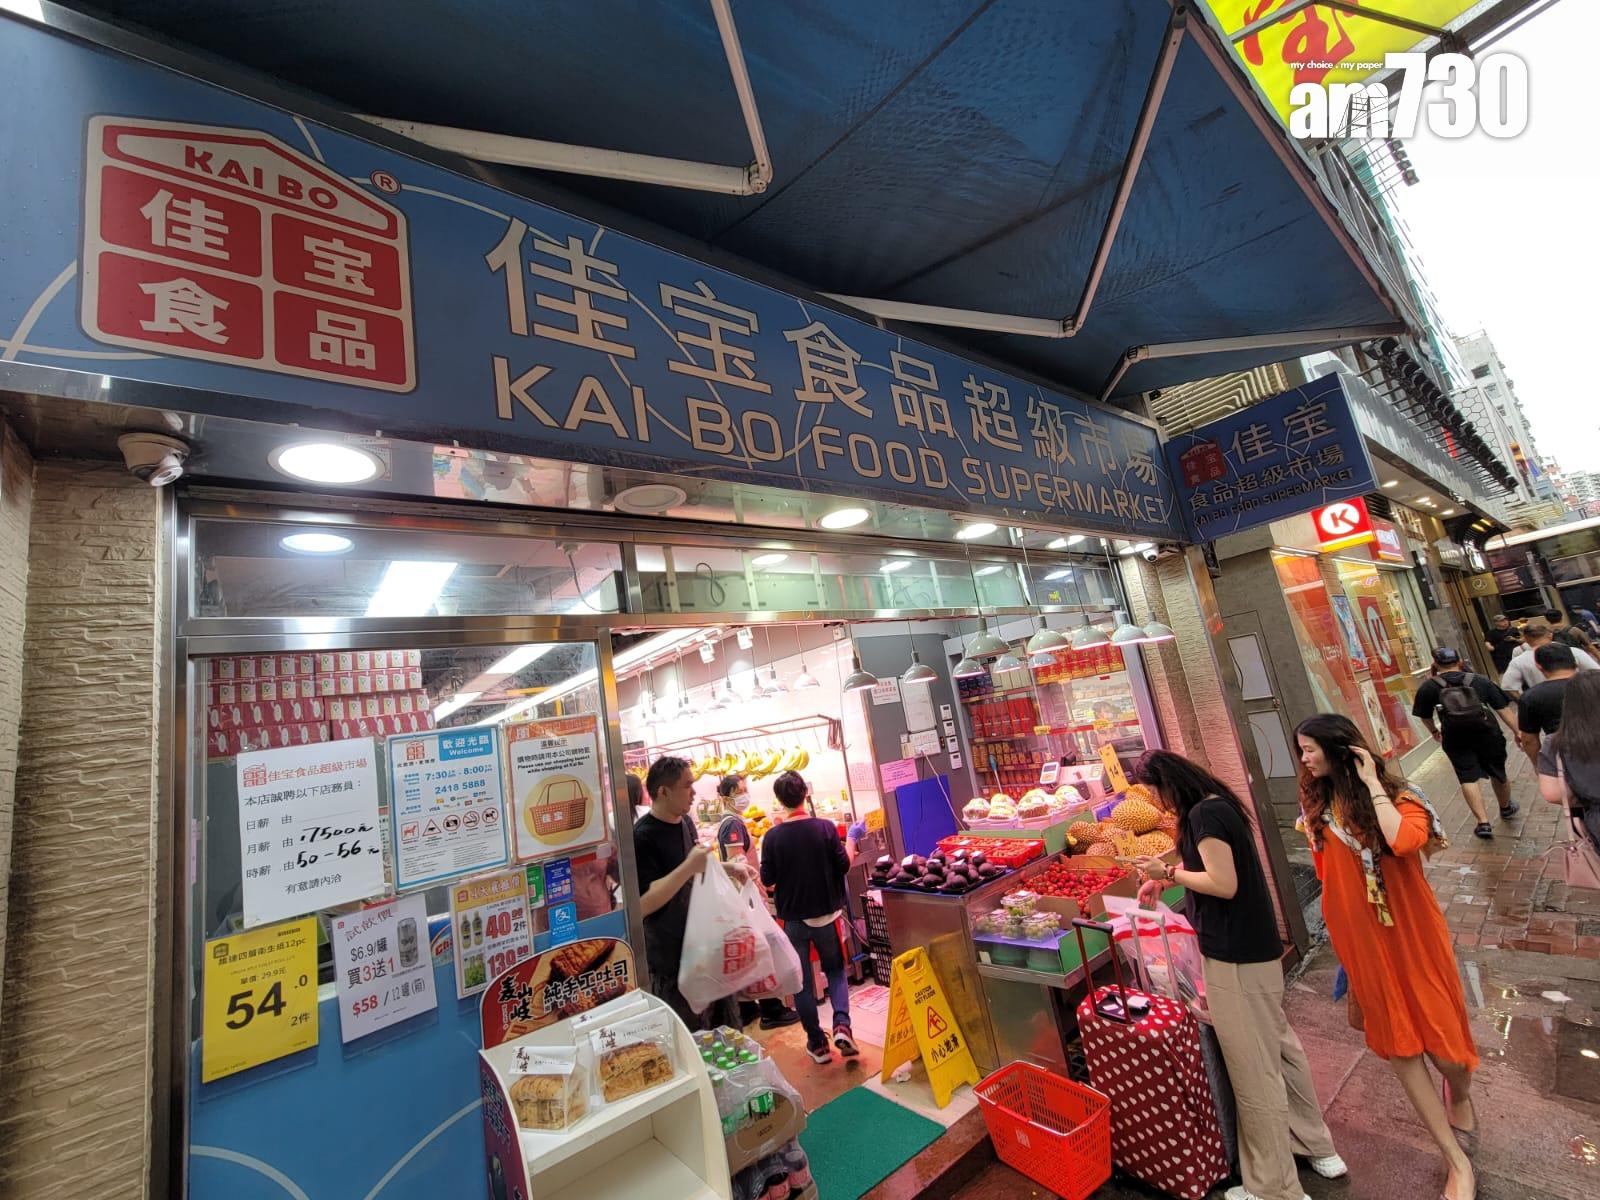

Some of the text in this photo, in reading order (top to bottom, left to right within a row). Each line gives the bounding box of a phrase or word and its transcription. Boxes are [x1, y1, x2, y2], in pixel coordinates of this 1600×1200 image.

[184, 145, 264, 189] KAI
[278, 174, 338, 210] BO
[484, 216, 1159, 488] 佳宝食品超級市場
[491, 353, 1168, 528] KAI BO FOOD SUPERMARKET
[1230, 401, 1338, 465] 佳宝
[1188, 443, 1346, 512] 食品超級市場
[1263, 467, 1355, 505] SUPERMARKET
[449, 746, 484, 757] Welcome
[424, 771, 448, 782] 7:30
[463, 765, 485, 776] 8:00
[434, 783, 459, 795] 2418
[246, 814, 293, 832] 日薪 由
[247, 837, 294, 855] 月薪 由
[246, 860, 295, 880] 時薪 由
[485, 911, 512, 940] 40
[347, 957, 395, 990] 買3送1
[543, 959, 629, 1003] 純手工吐司
[225, 981, 287, 1031] 54
[352, 994, 378, 1018] $58
[914, 985, 932, 998] CAUTION
[290, 1012, 310, 1027] 2件
